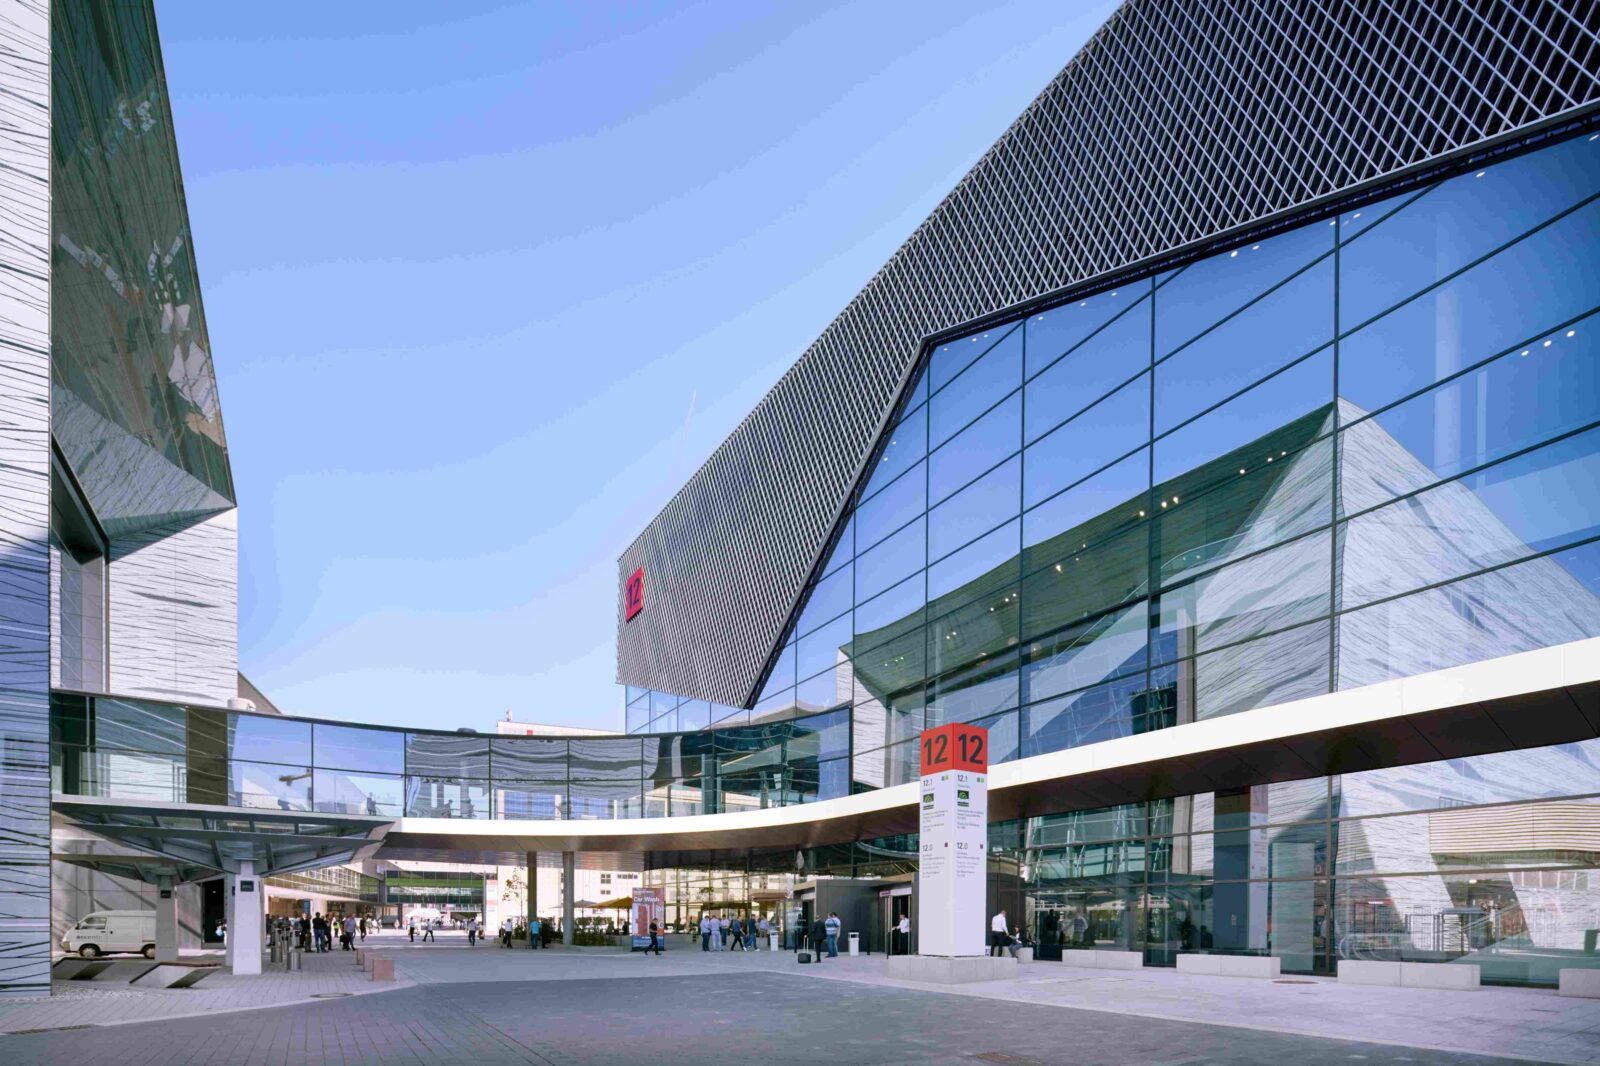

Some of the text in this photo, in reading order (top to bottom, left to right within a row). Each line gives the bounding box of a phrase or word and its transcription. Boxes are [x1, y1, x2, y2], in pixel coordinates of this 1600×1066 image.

[628, 578, 640, 608] 12
[924, 734, 948, 766] 12
[958, 733, 983, 765] 12
[957, 842, 968, 850] 12.0
